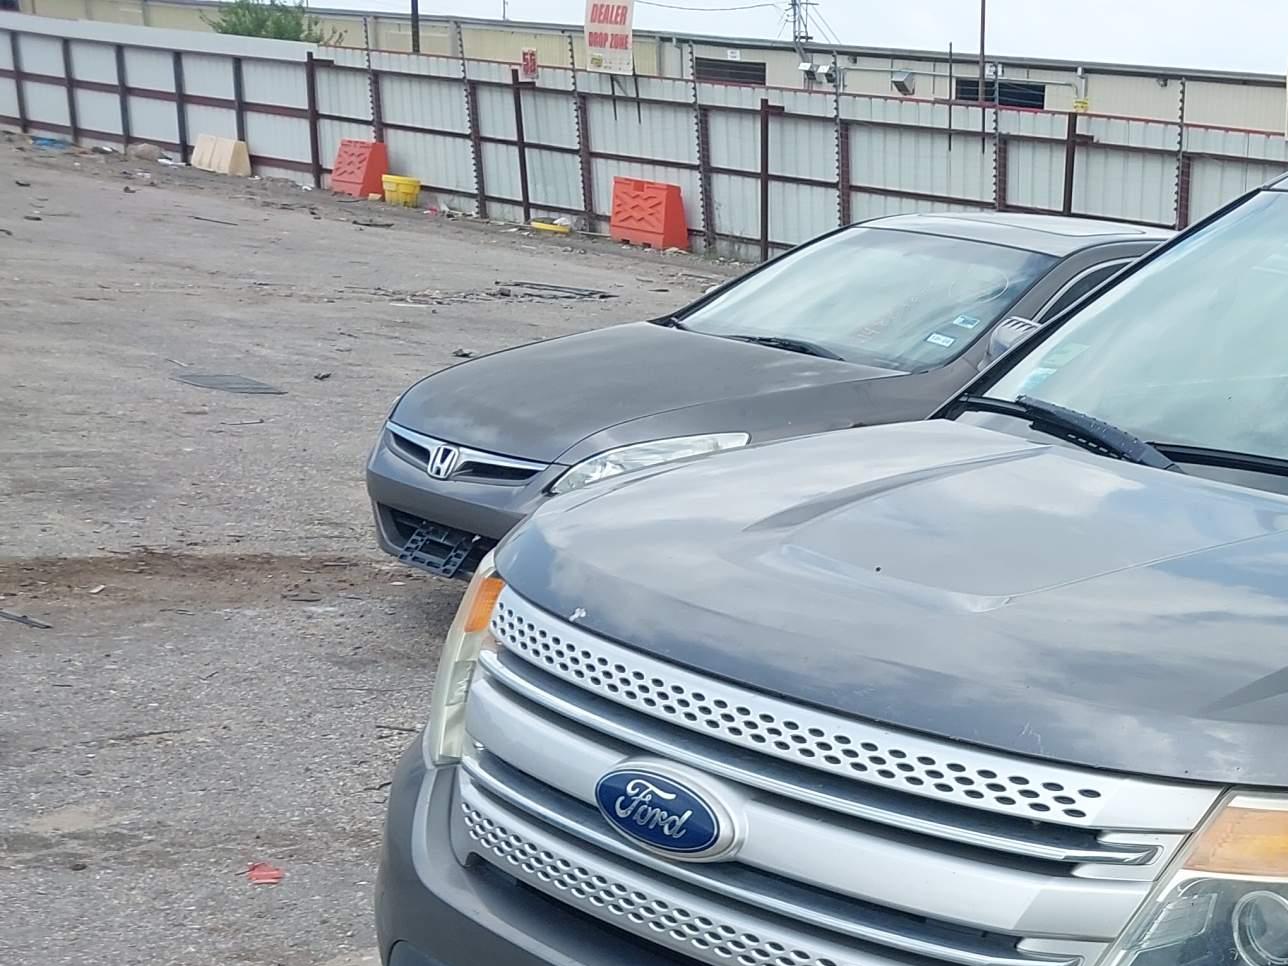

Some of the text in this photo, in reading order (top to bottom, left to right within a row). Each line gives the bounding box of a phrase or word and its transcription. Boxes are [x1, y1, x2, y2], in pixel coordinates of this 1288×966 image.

[590, 3, 628, 25] DEALER
[588, 31, 629, 50] DROP ZONE
[615, 778, 693, 839] Ford
